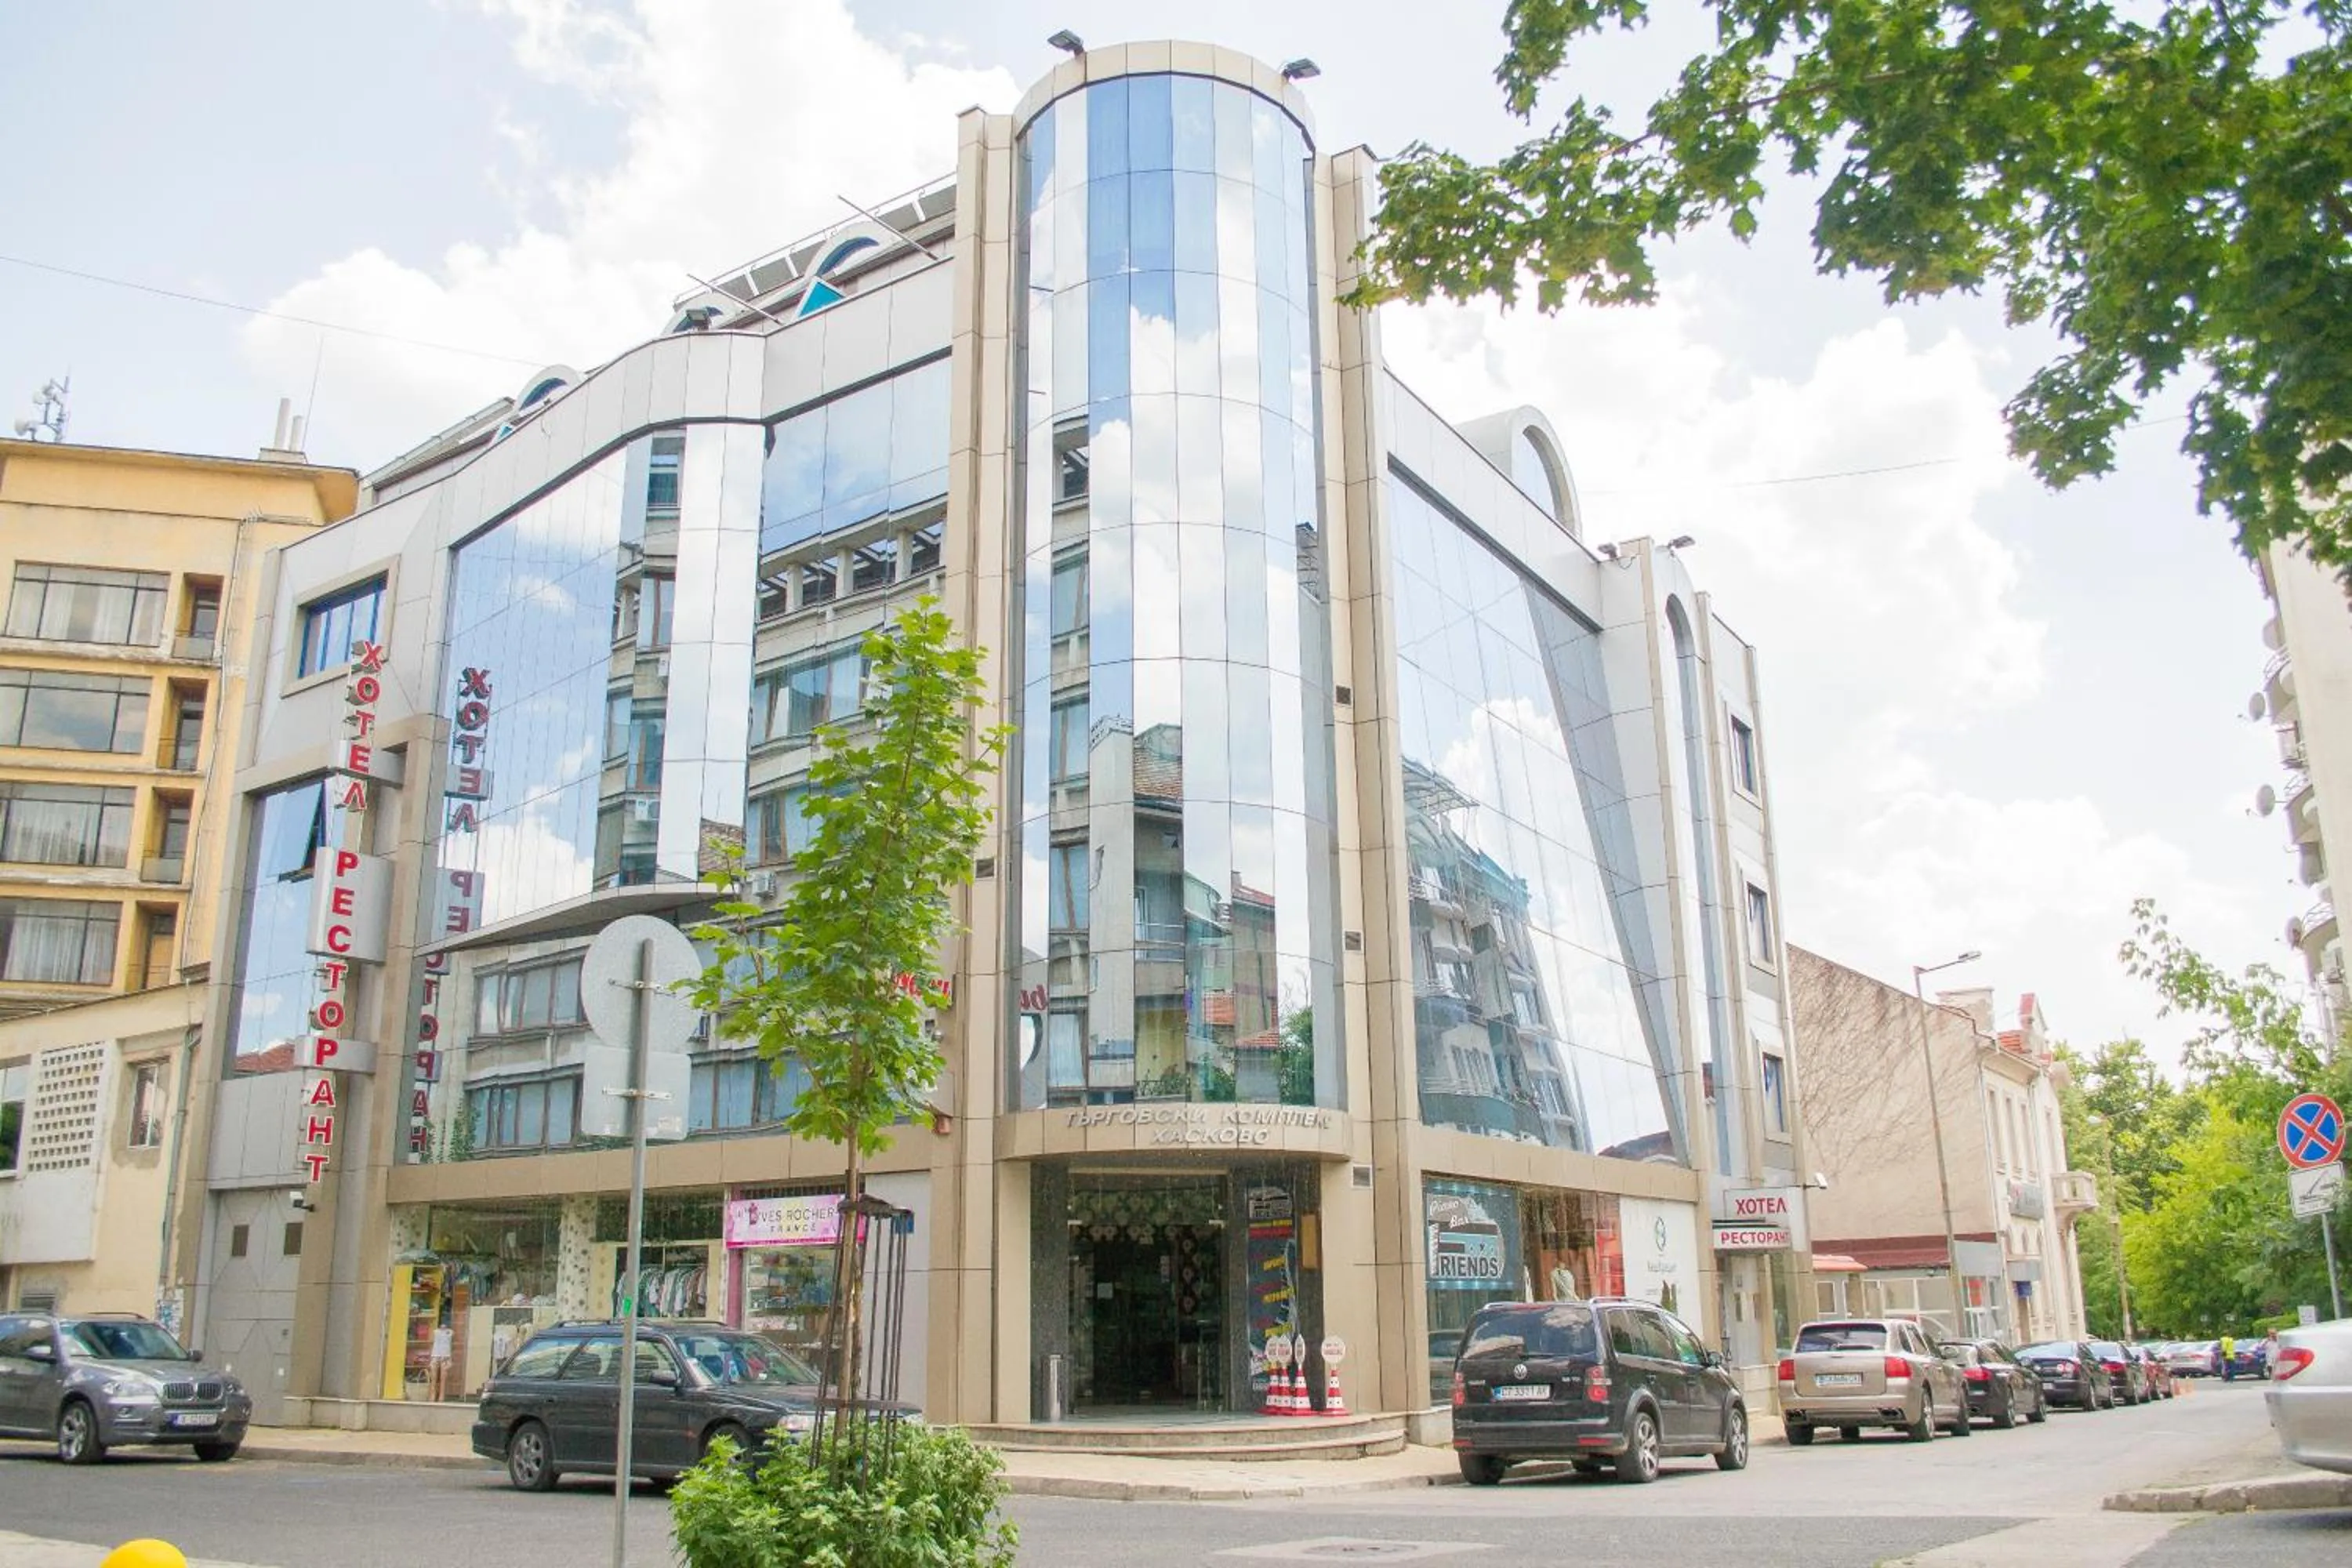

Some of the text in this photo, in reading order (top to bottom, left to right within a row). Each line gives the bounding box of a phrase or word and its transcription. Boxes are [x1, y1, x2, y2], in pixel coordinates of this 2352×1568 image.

[305, 639, 383, 1183] ХОТЕЛ РЕСТОРАНТ
[1065, 1108, 1332, 1130] ТЪРГОВСКИ КОМПЛЕКС
[1150, 1127, 1271, 1145] ХАСКОВО
[1735, 1196, 1788, 1214] ХОТЕЛ
[756, 1209, 782, 1222] VES
[1720, 1231, 1790, 1245] РЕСТОРАНТ
